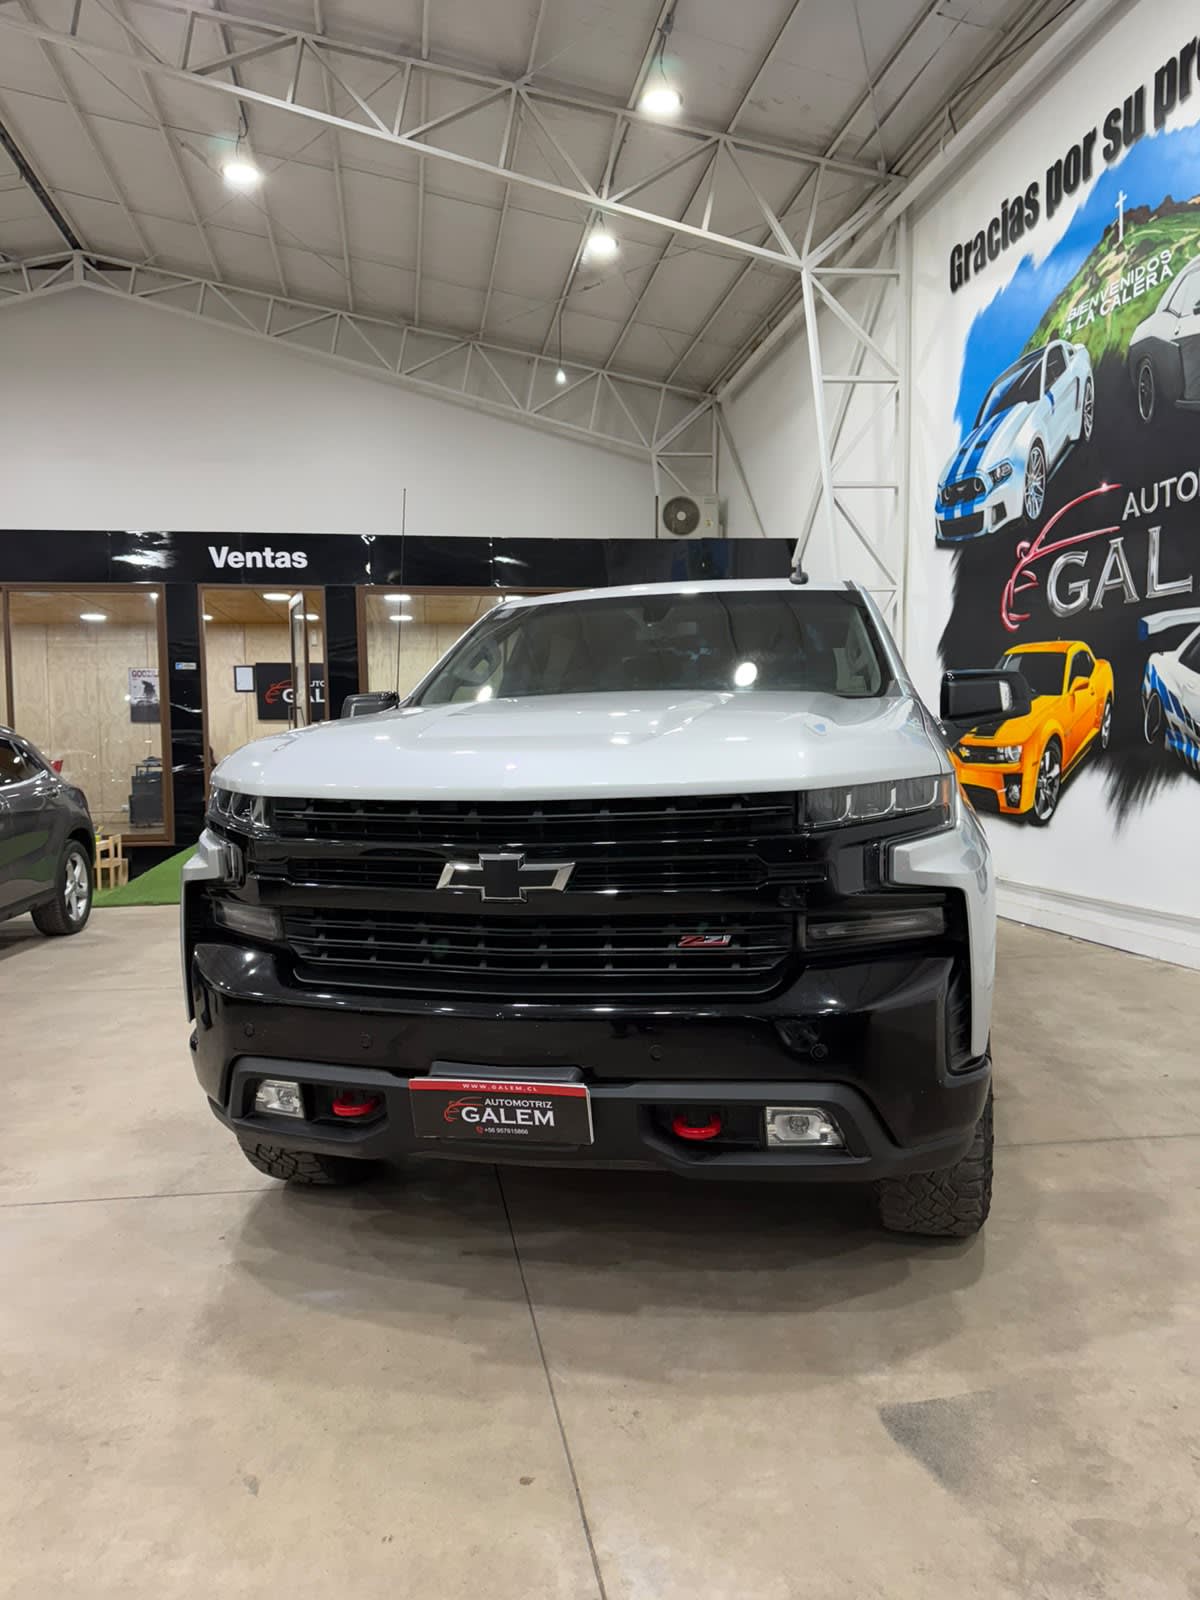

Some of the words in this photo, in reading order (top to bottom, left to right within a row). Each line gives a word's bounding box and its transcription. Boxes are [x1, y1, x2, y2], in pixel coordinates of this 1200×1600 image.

[950, 181, 1040, 293] Gracias
[1045, 127, 1097, 219] por
[1102, 84, 1146, 163] su
[1153, 36, 1200, 129] pr
[1075, 308, 1095, 330] LA
[1099, 264, 1173, 316] CALERA
[1121, 468, 1200, 521] AUTO
[208, 546, 308, 568] Ventas
[461, 1106, 555, 1127] GALEM
[484, 1098, 553, 1109] AUTOMOTRIZ
